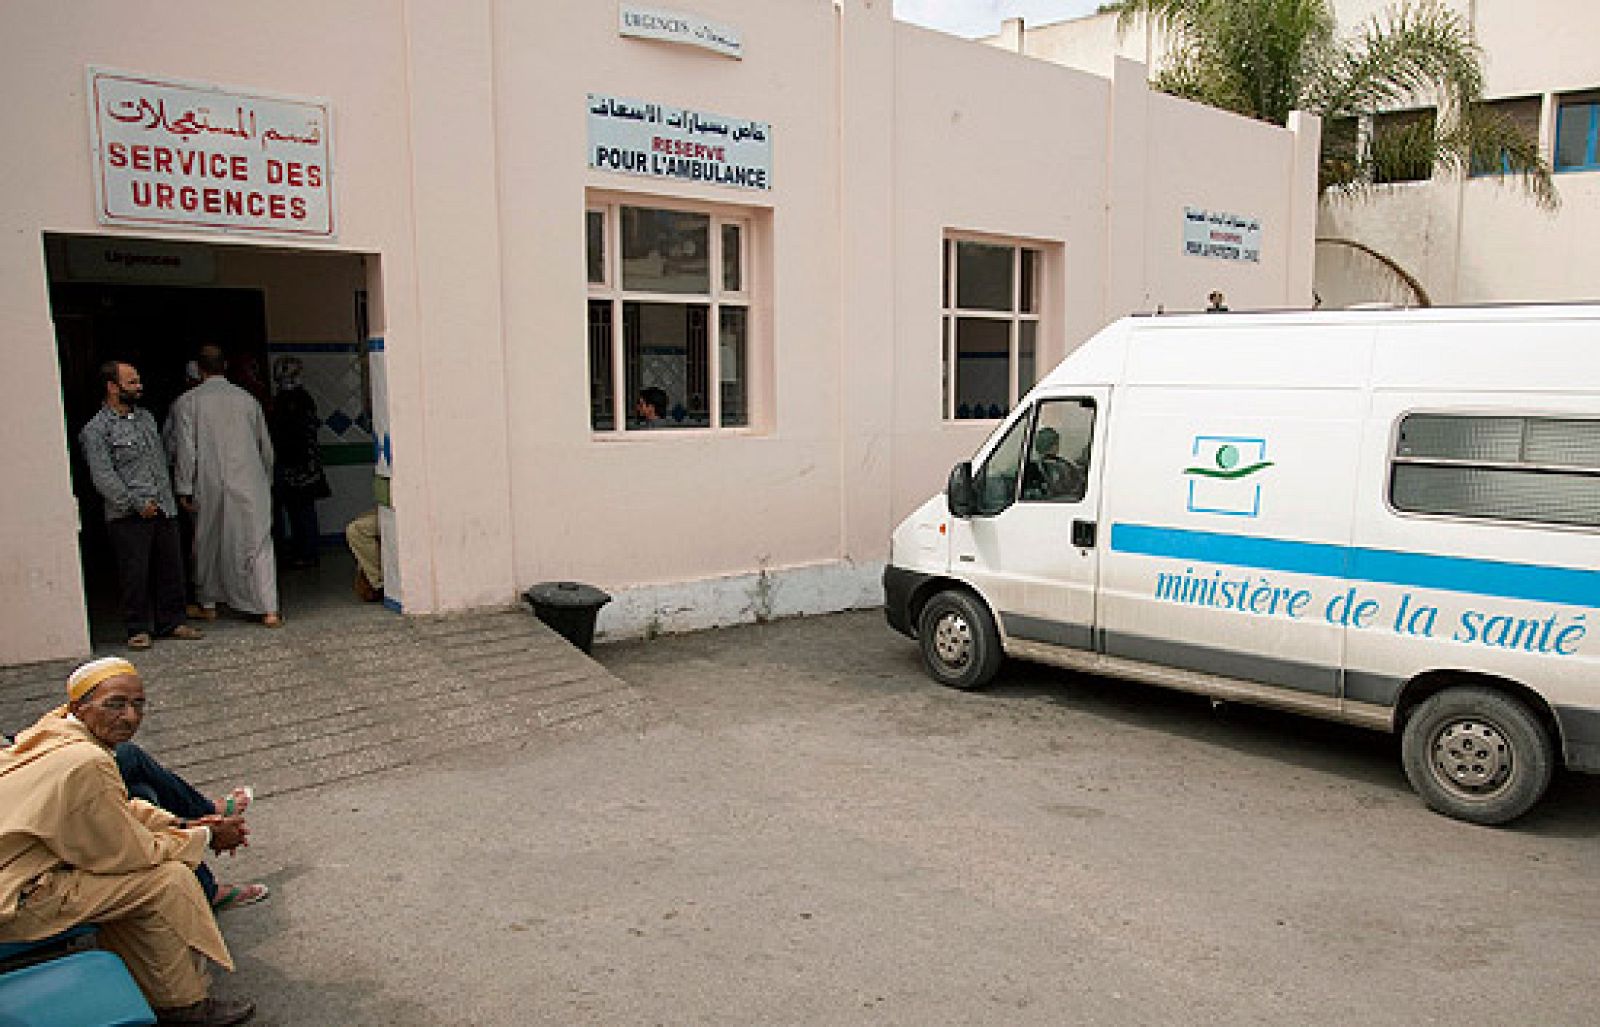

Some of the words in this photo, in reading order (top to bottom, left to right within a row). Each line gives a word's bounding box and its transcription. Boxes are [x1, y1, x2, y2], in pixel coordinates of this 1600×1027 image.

[624, 10, 690, 33] URGENCES
[261, 119, 321, 150] قسم
[107, 142, 248, 182] SERVICE
[267, 159, 321, 187] DES
[596, 145, 647, 172] POUR
[652, 153, 766, 190] L'AMBULANCE
[131, 180, 307, 219] URGENCES
[1153, 566, 1312, 618] ministère
[1325, 587, 1380, 629] de
[1393, 593, 1439, 637] la
[1452, 611, 1588, 656] santé
